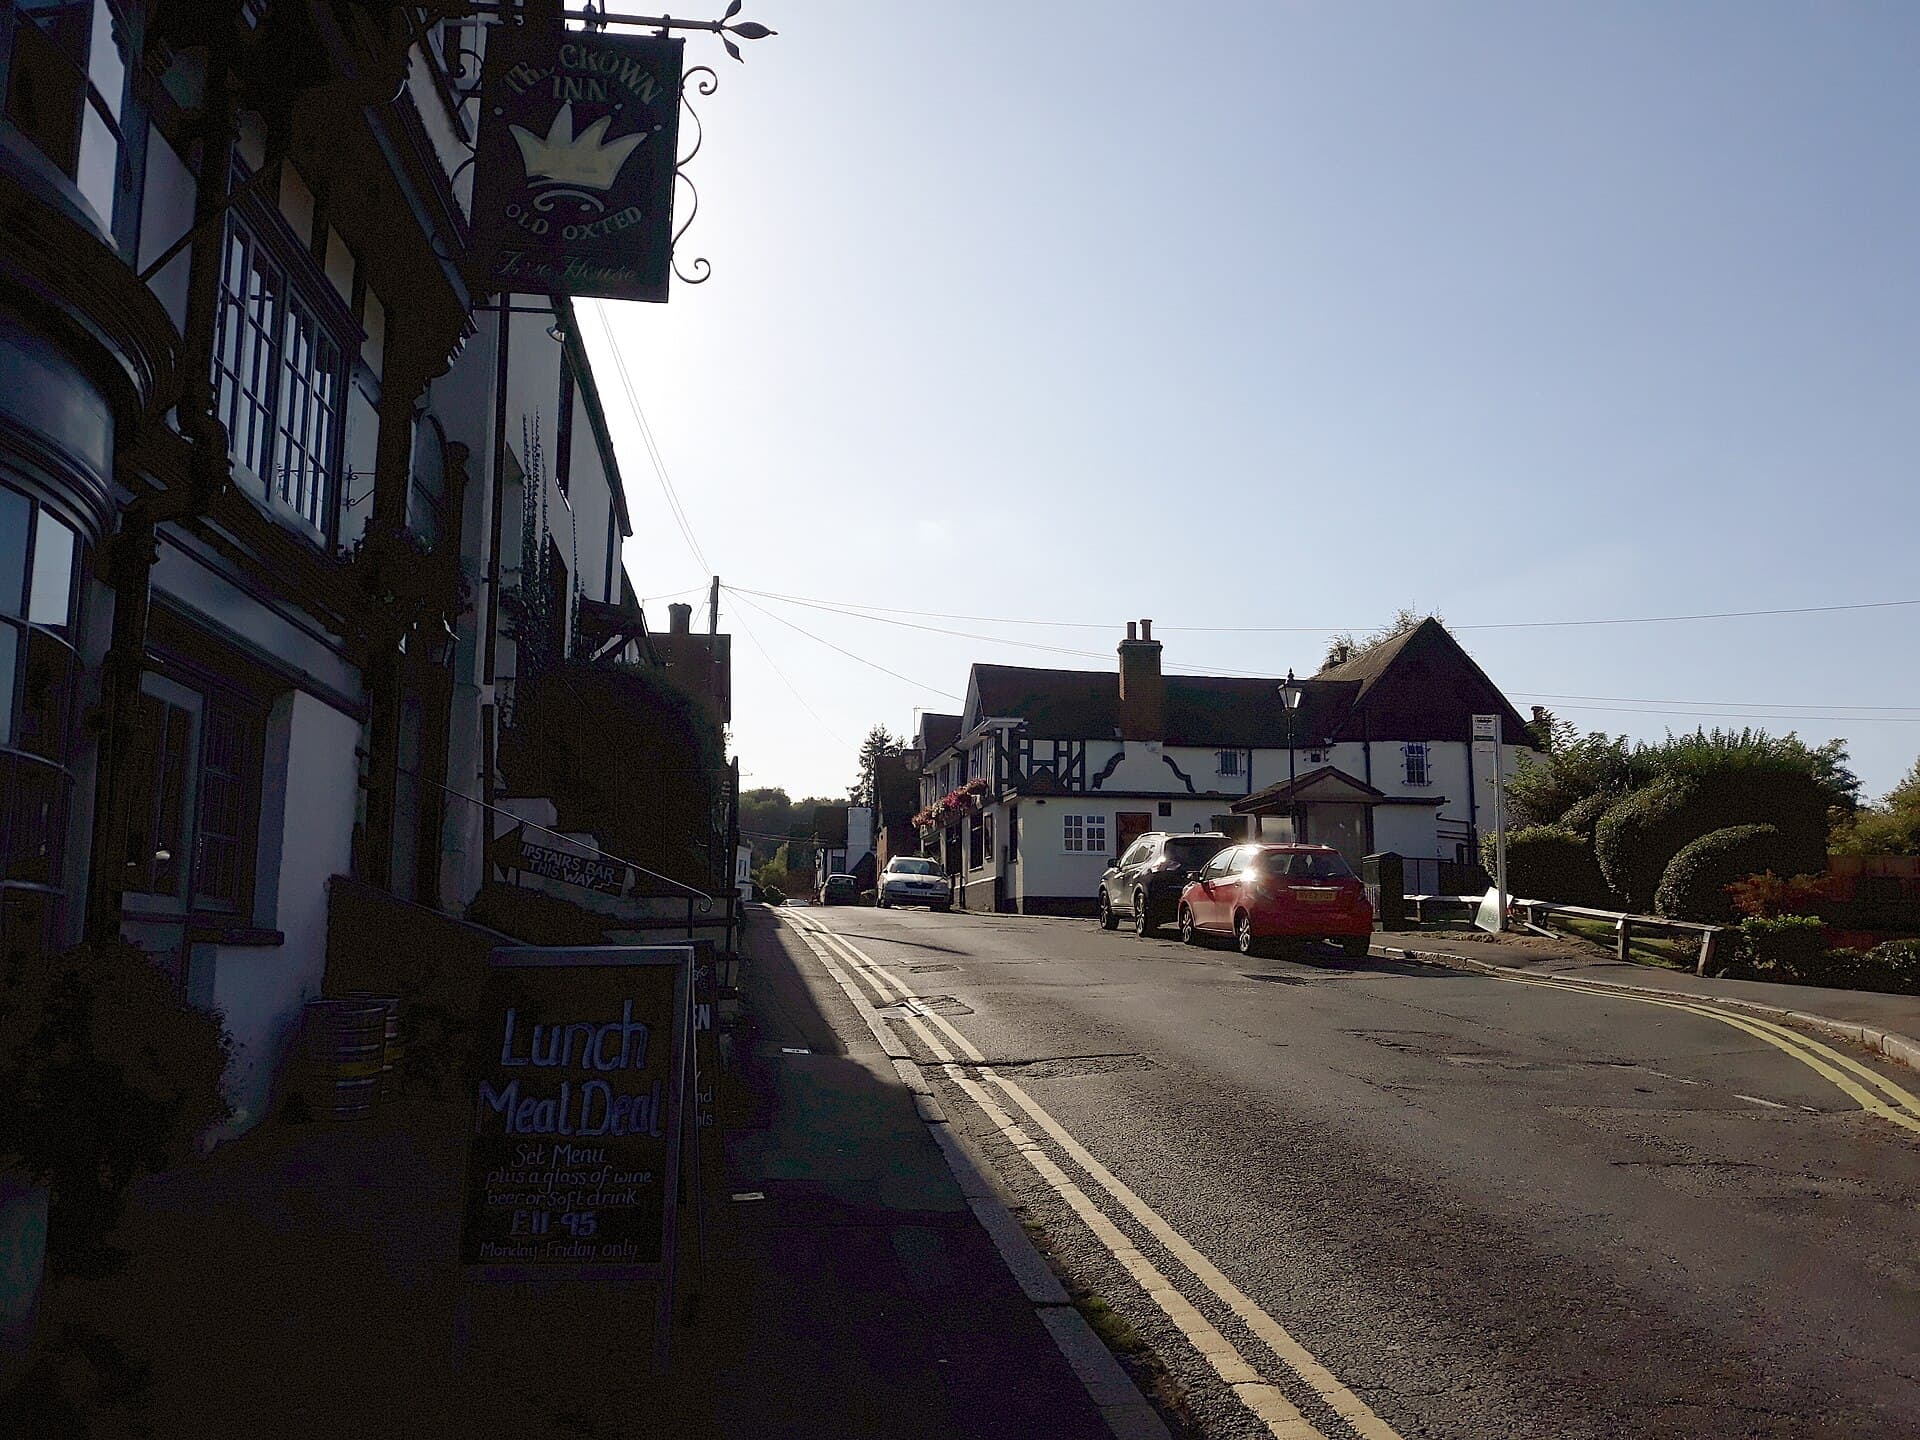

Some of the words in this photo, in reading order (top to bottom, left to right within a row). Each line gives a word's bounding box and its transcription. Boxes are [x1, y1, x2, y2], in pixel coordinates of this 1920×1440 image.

[559, 43, 663, 104] CROWN
[552, 75, 608, 102] INN
[505, 203, 549, 235] OLD
[562, 206, 642, 240] OXTED
[529, 859, 560, 878] THIS
[563, 867, 594, 887] WAY
[585, 862, 615, 883] BAR
[501, 999, 649, 1071] Lunch
[476, 1079, 574, 1135] Meal
[575, 1079, 663, 1138] Deal
[511, 1143, 545, 1168] Set
[551, 1144, 608, 1168] Menu
[485, 1166, 525, 1190] plus
[528, 1172, 540, 1184] a
[540, 1168, 586, 1194] glass
[590, 1165, 612, 1189] of
[614, 1171, 653, 1184] wine
[487, 1189, 525, 1205] beer
[526, 1193, 546, 1205] or
[587, 1188, 639, 1206] drink
[602, 1238, 639, 1263] only
